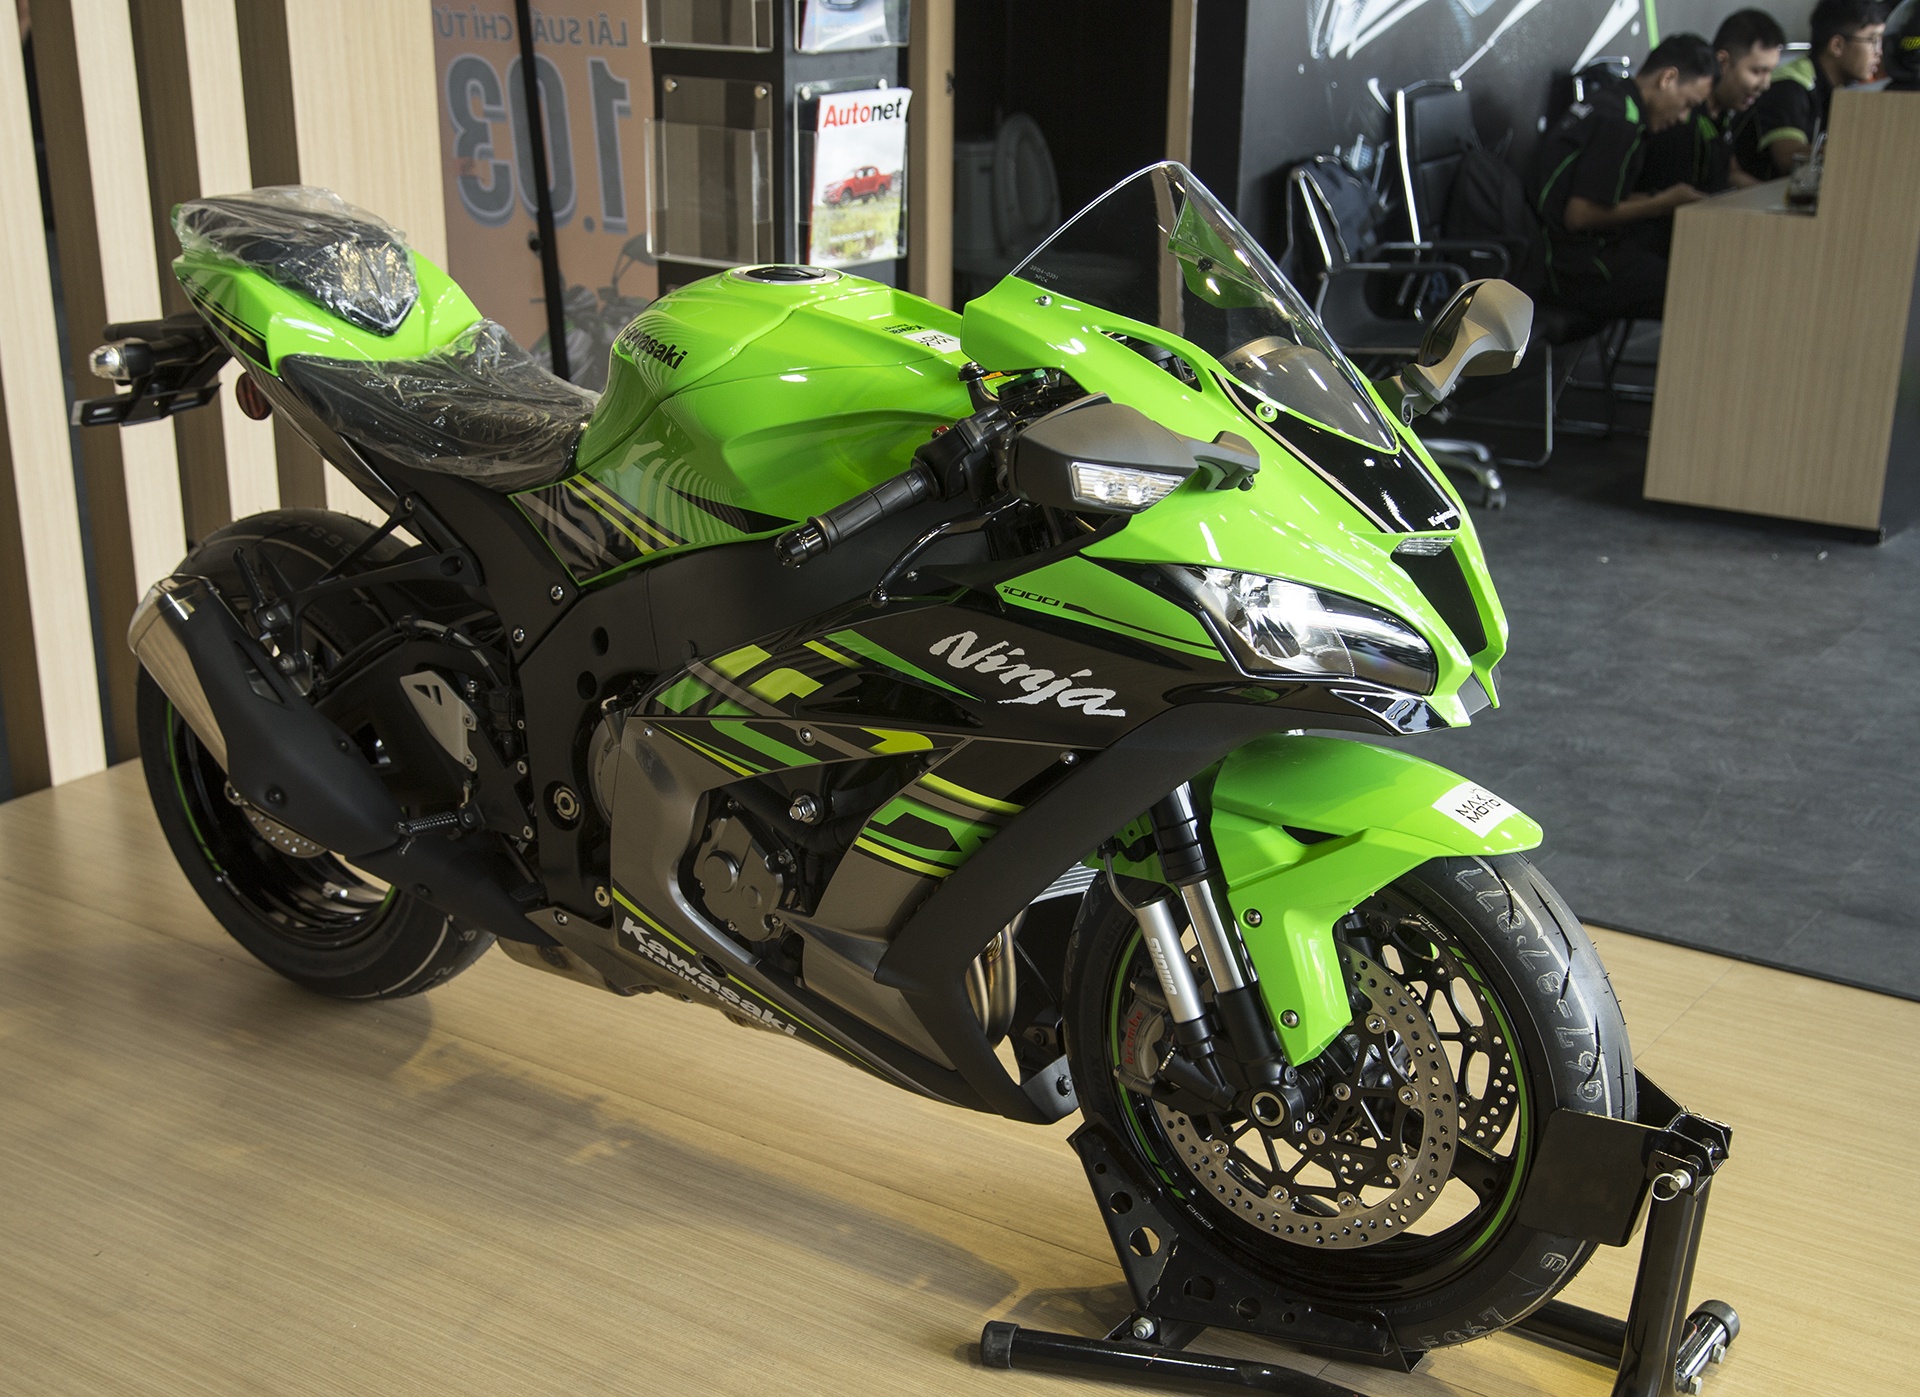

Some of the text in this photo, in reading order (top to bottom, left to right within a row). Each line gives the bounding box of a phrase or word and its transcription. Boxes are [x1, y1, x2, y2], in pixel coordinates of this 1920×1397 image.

[823, 98, 903, 128] Autonet
[1003, 585, 1060, 607] 1000
[929, 630, 1126, 717] Ninja
[1455, 794, 1487, 817] MAX
[1466, 799, 1502, 824] MOTO
[1416, 914, 1448, 941] 1000
[622, 916, 797, 1036] Kawasaki
[638, 944, 711, 994] Racing
[1124, 1010, 1143, 1065] brembo
